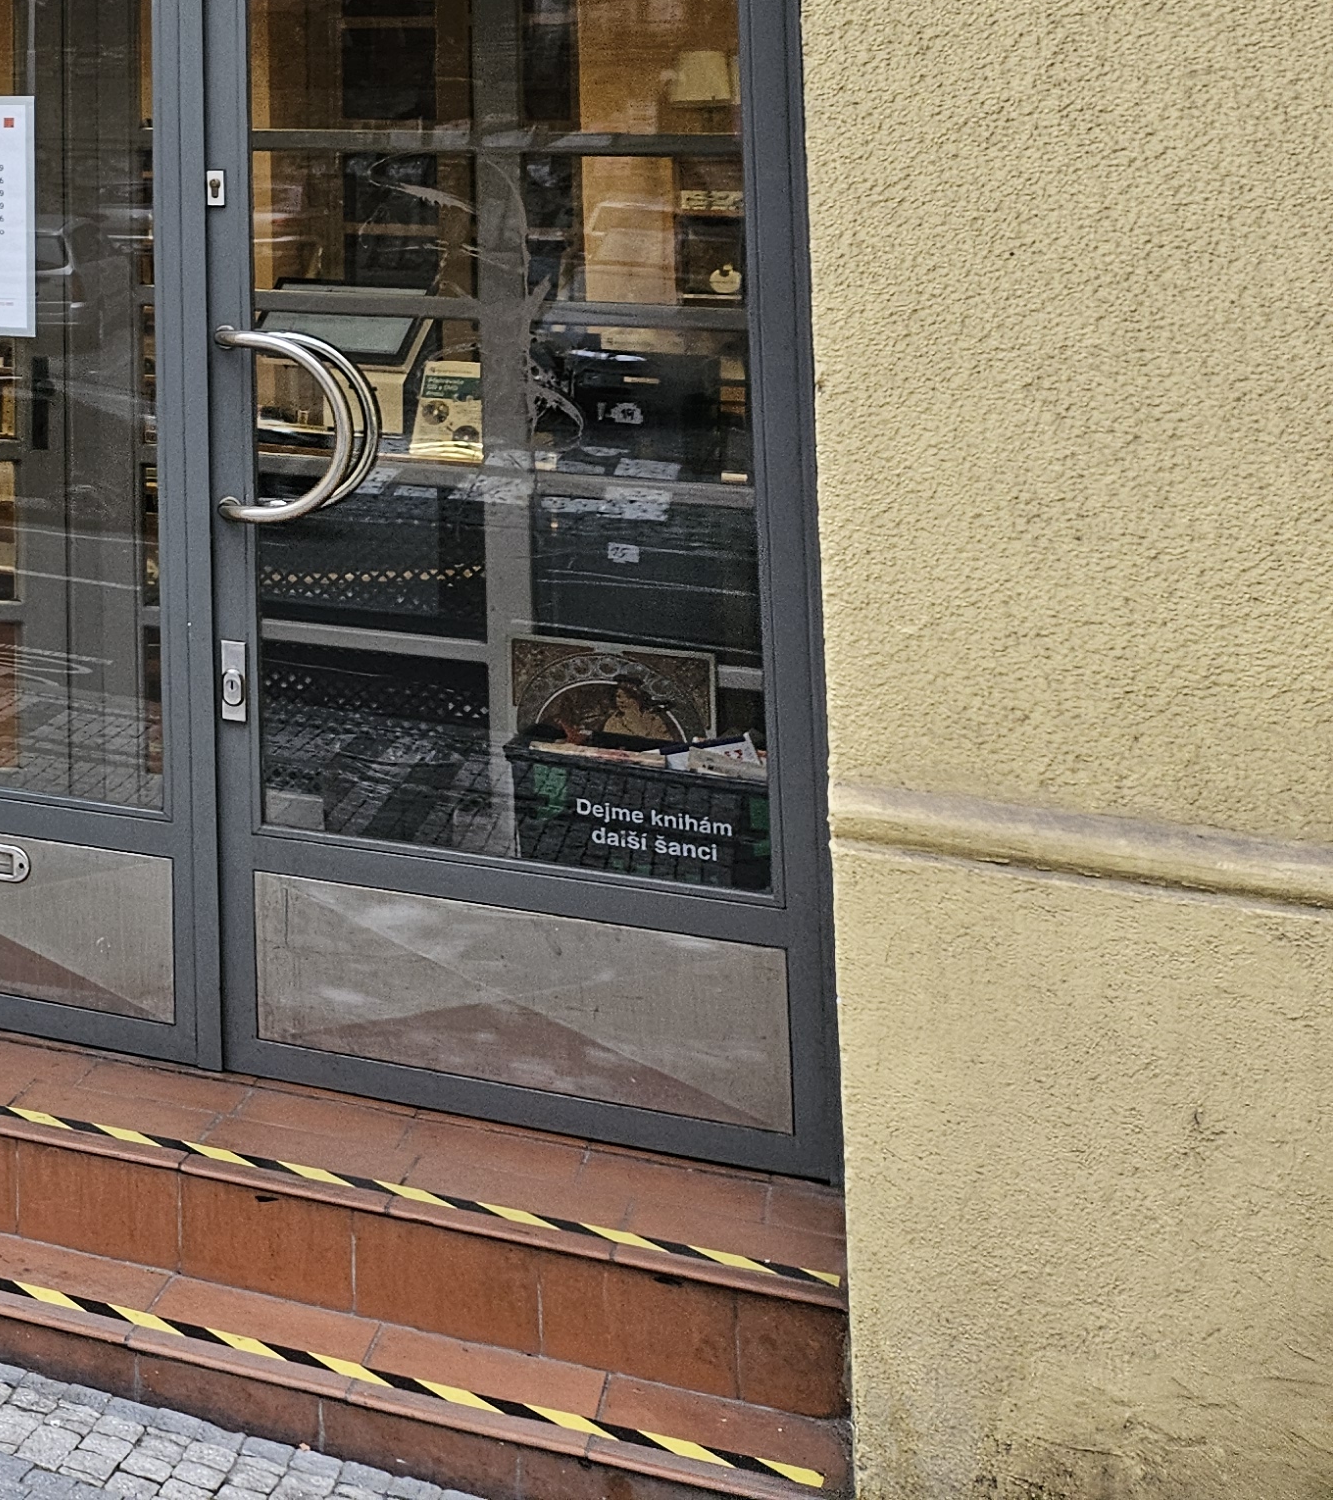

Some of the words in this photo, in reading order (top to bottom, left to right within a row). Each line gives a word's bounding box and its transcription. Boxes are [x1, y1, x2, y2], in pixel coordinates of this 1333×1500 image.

[576, 798, 644, 823] Dejme
[651, 809, 733, 837] knihám
[591, 827, 648, 851] další
[654, 835, 718, 862] šanci
